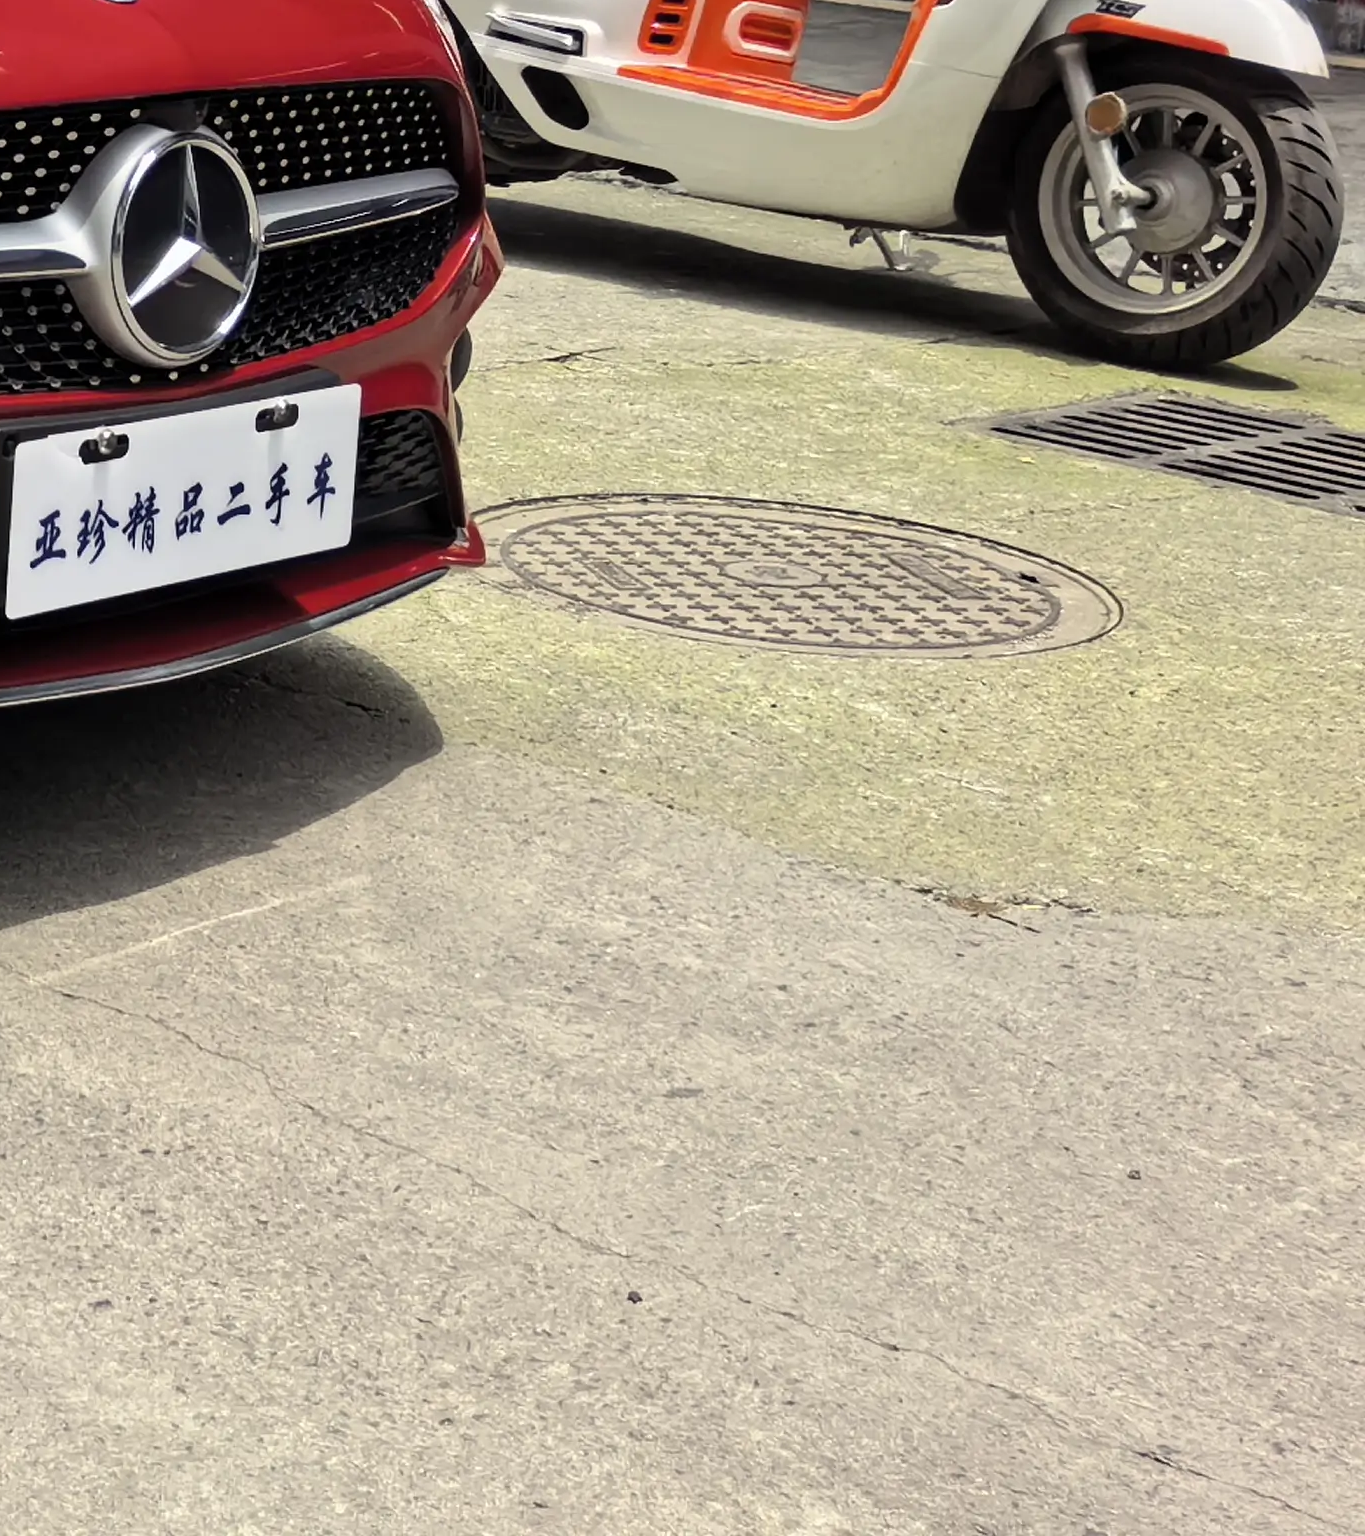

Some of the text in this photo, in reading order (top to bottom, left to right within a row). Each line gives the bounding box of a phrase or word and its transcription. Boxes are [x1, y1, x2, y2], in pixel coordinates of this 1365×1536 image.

[29, 451, 337, 570] 亚珍精品二手车
